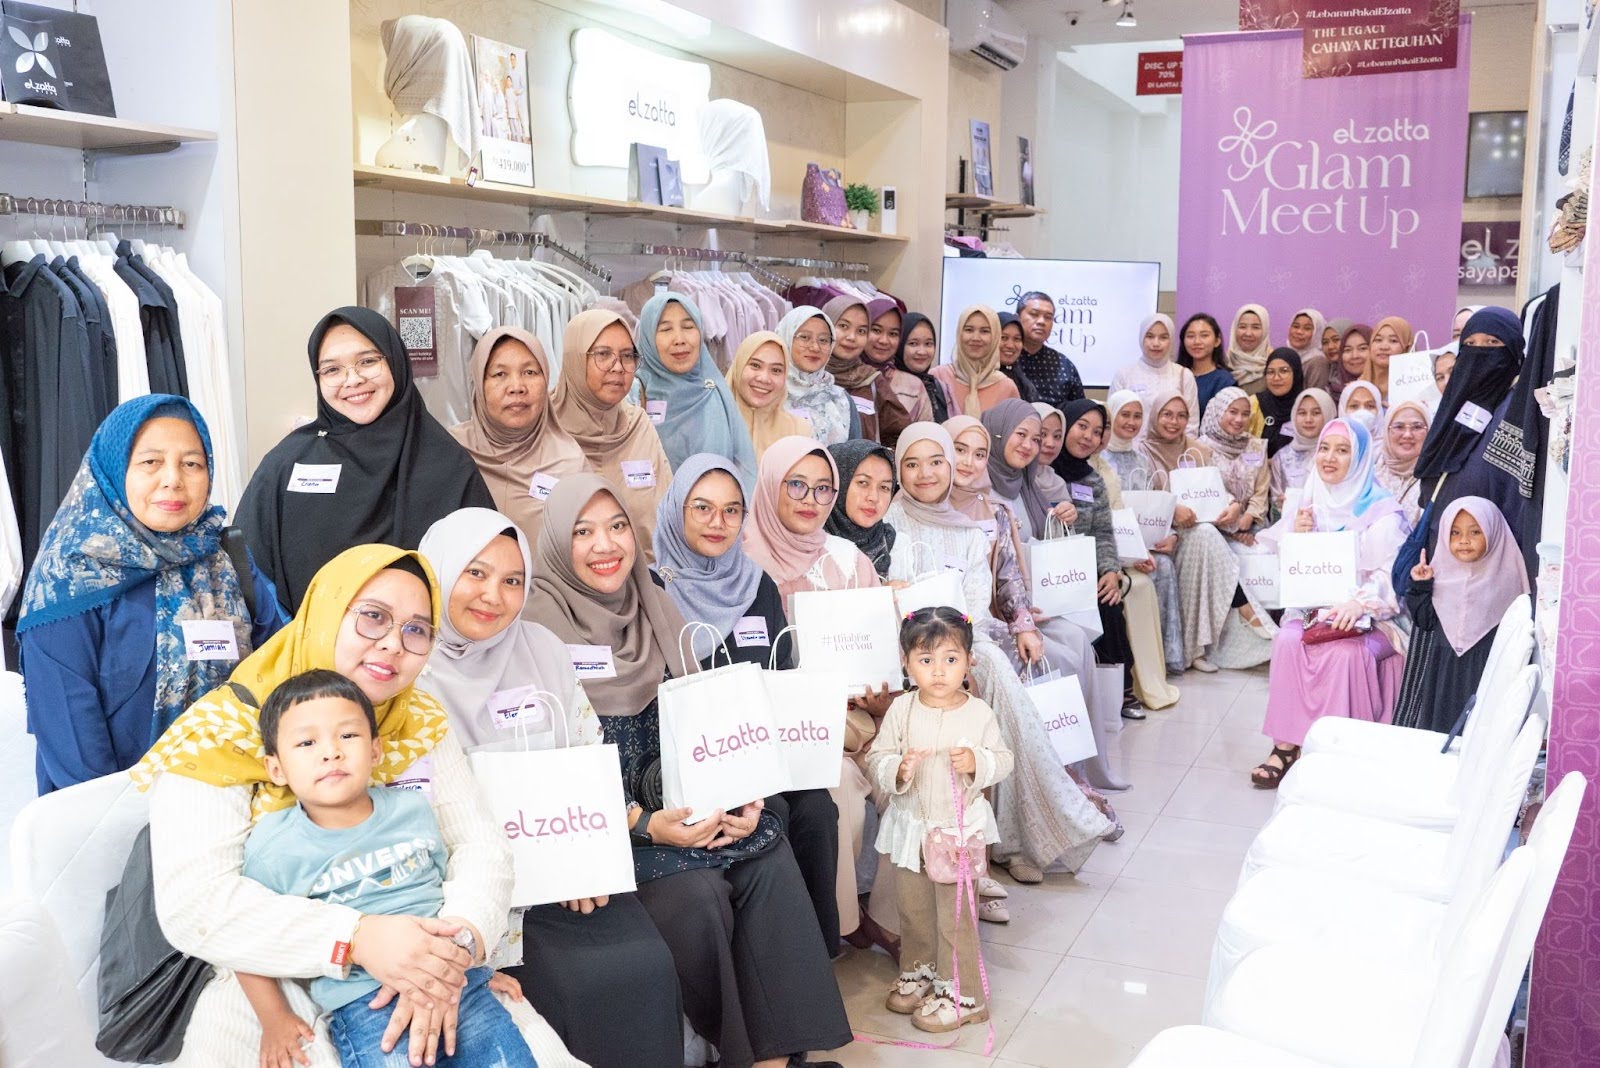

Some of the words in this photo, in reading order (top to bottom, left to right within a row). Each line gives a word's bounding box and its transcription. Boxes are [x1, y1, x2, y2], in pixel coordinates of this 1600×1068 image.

[1305, 7, 1412, 19] #LebaranPakaiElzatta
[1312, 27, 1337, 38] THE
[1341, 24, 1386, 37] LEGACY
[1311, 40, 1361, 54] CAHAYA
[1363, 33, 1443, 51] KETEGUHAN
[1166, 61, 1178, 69] UP
[1158, 70, 1176, 79] 70%
[1155, 81, 1179, 89] LANTAI
[1264, 140, 1411, 191] Glam
[1220, 187, 1349, 236] Meet
[1359, 195, 1420, 249] Up
[1069, 328, 1096, 353] Up
